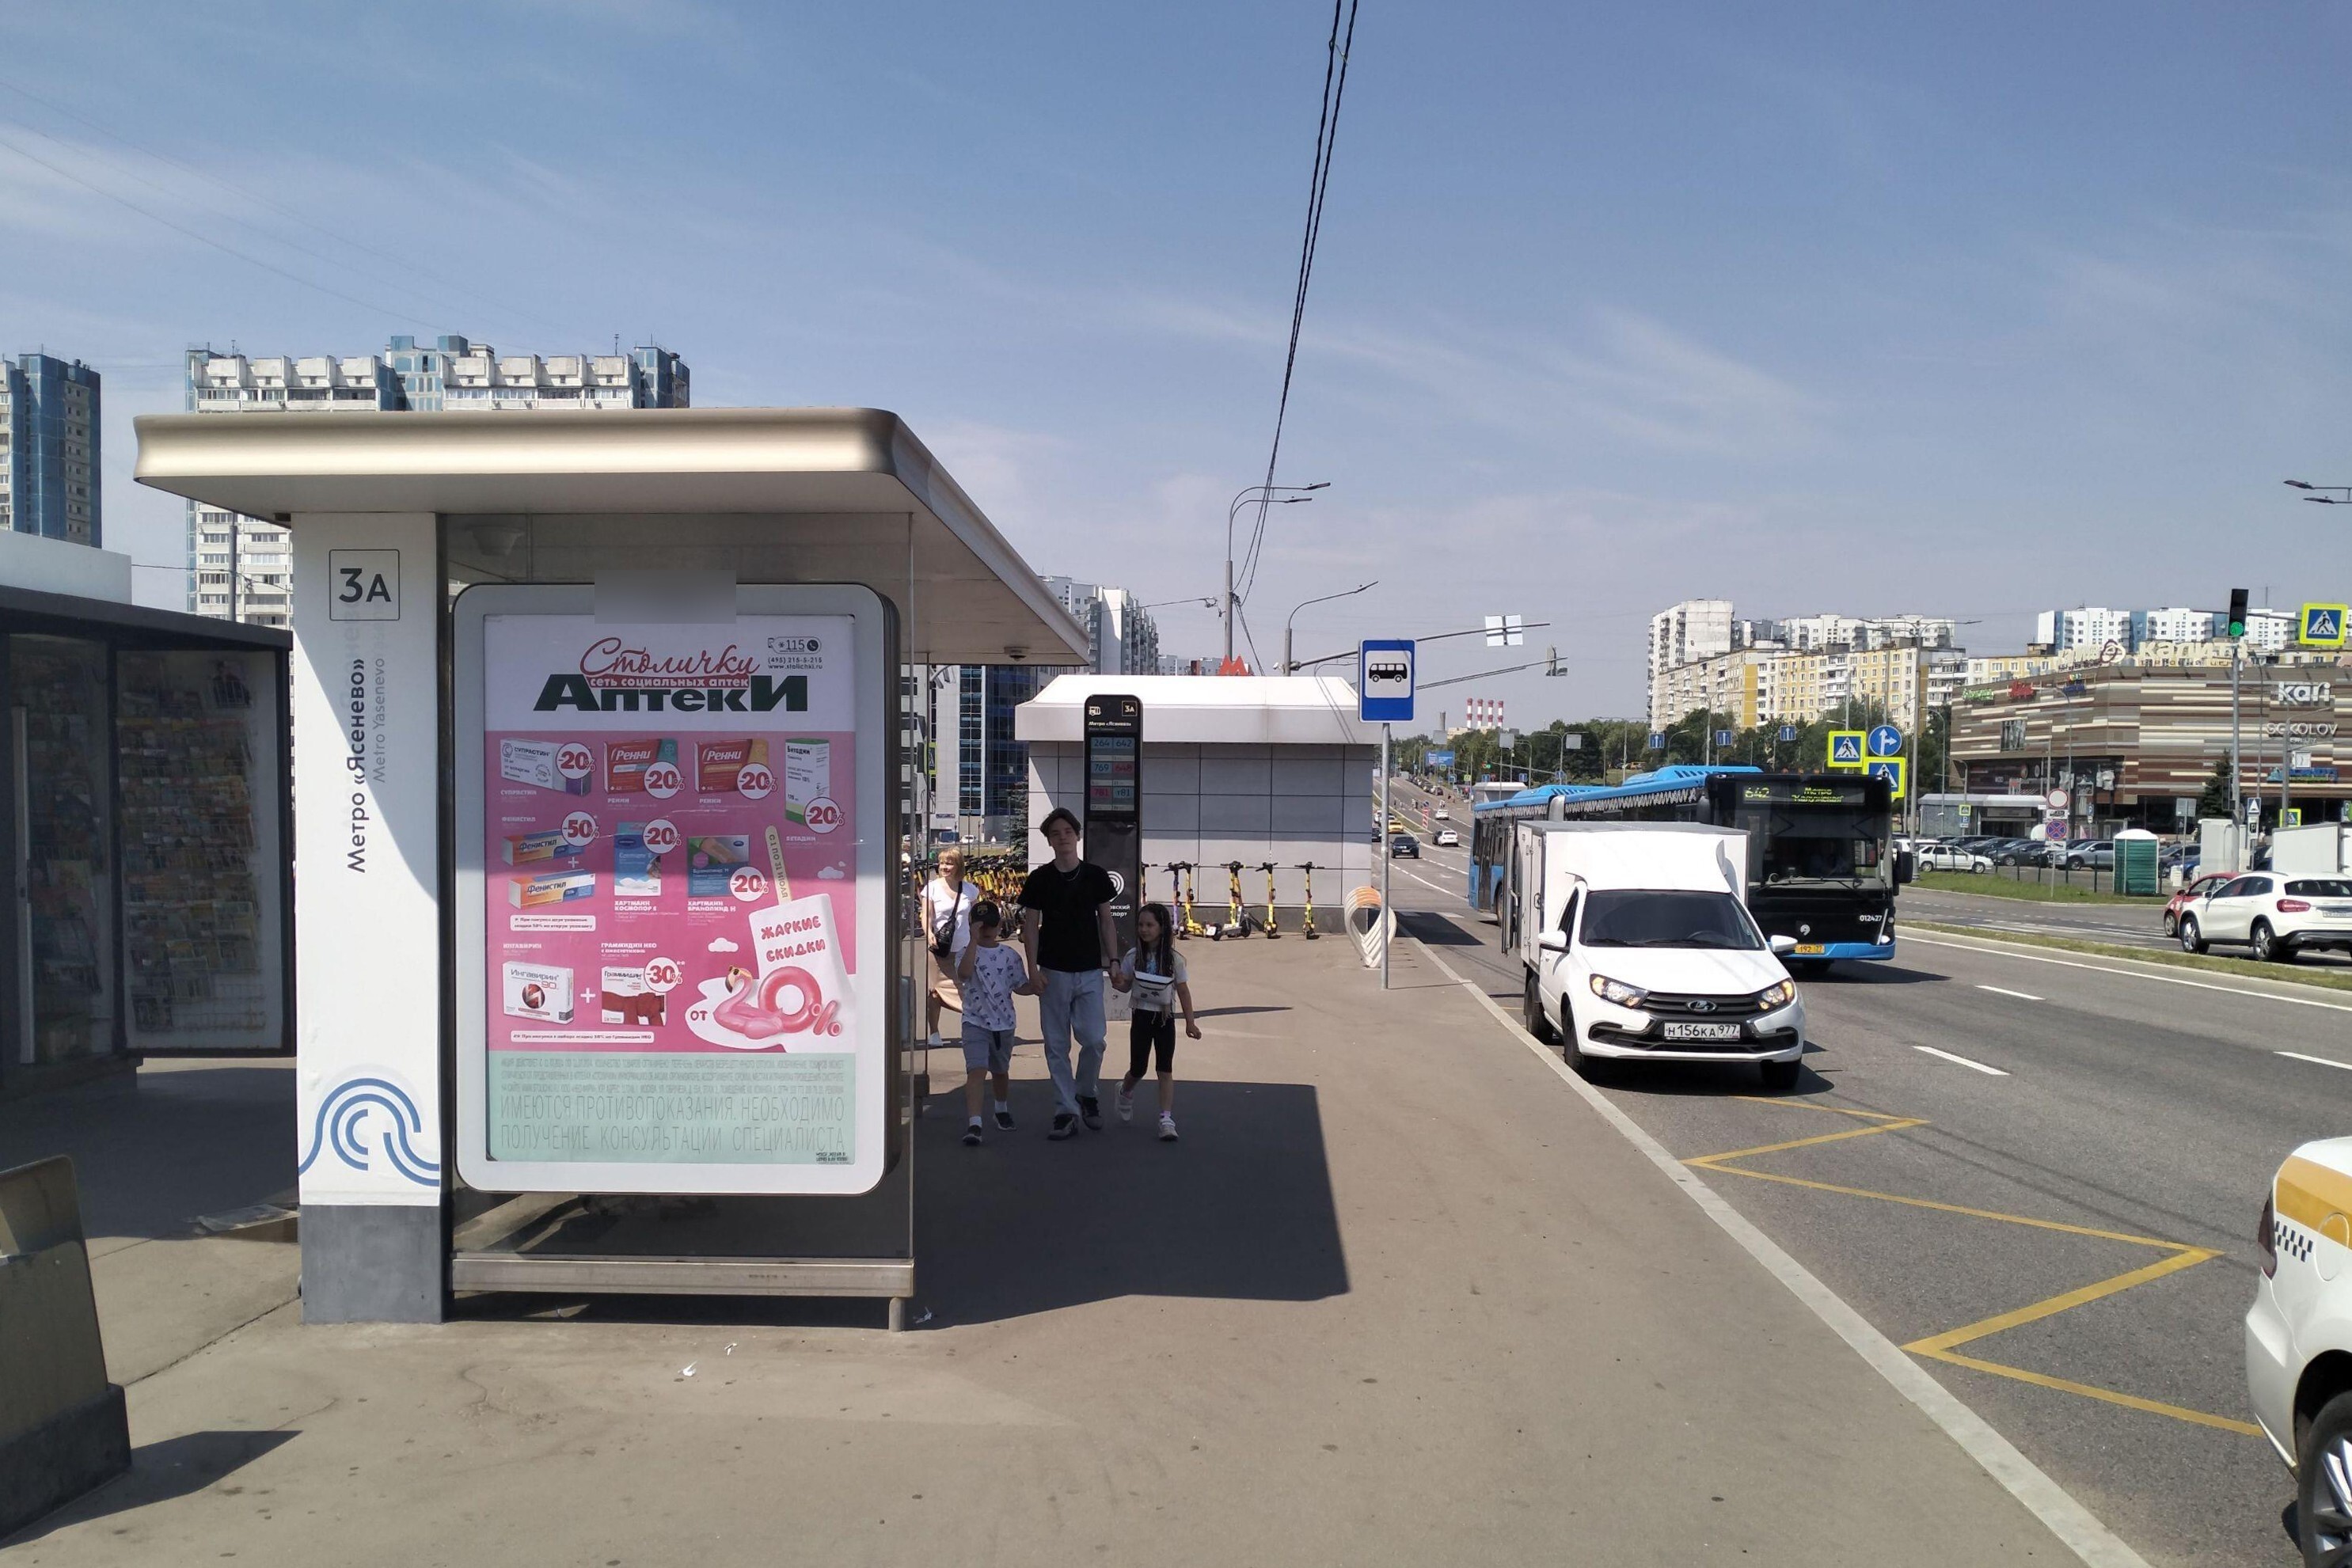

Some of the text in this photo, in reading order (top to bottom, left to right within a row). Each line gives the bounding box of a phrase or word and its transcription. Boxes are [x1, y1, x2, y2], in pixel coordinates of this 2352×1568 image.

[338, 568, 392, 603] 3А
[579, 636, 761, 676] Столички
[768, 656, 786, 665] (495)
[590, 678, 748, 689] сеть социальных аптек
[2278, 681, 2331, 703] kari
[346, 658, 366, 785] «Ясенево»
[373, 658, 387, 783] Metro Yasenevo
[1093, 738, 1132, 747] 264 642
[616, 750, 652, 761] Ренни
[707, 750, 743, 761] Ренни
[1094, 763, 1109, 773] 769
[347, 792, 370, 874] Метро
[526, 880, 567, 894] Фенистил
[761, 915, 822, 940] ЖАРКИЕ
[766, 939, 826, 962] СКИДКИ
[511, 969, 557, 981] Ингавирин
[1718, 1024, 1738, 1035] 977
[501, 1095, 845, 1124] ИМЕЮТСЯ ПРОТИВОПОКАЗАНИЯ. НЕОБХОДИМО
[501, 1124, 845, 1154] ПОЛУЧЕНИЕ КОНСУЛЬТАЦИИ СПЕЦИАЛИСТА
